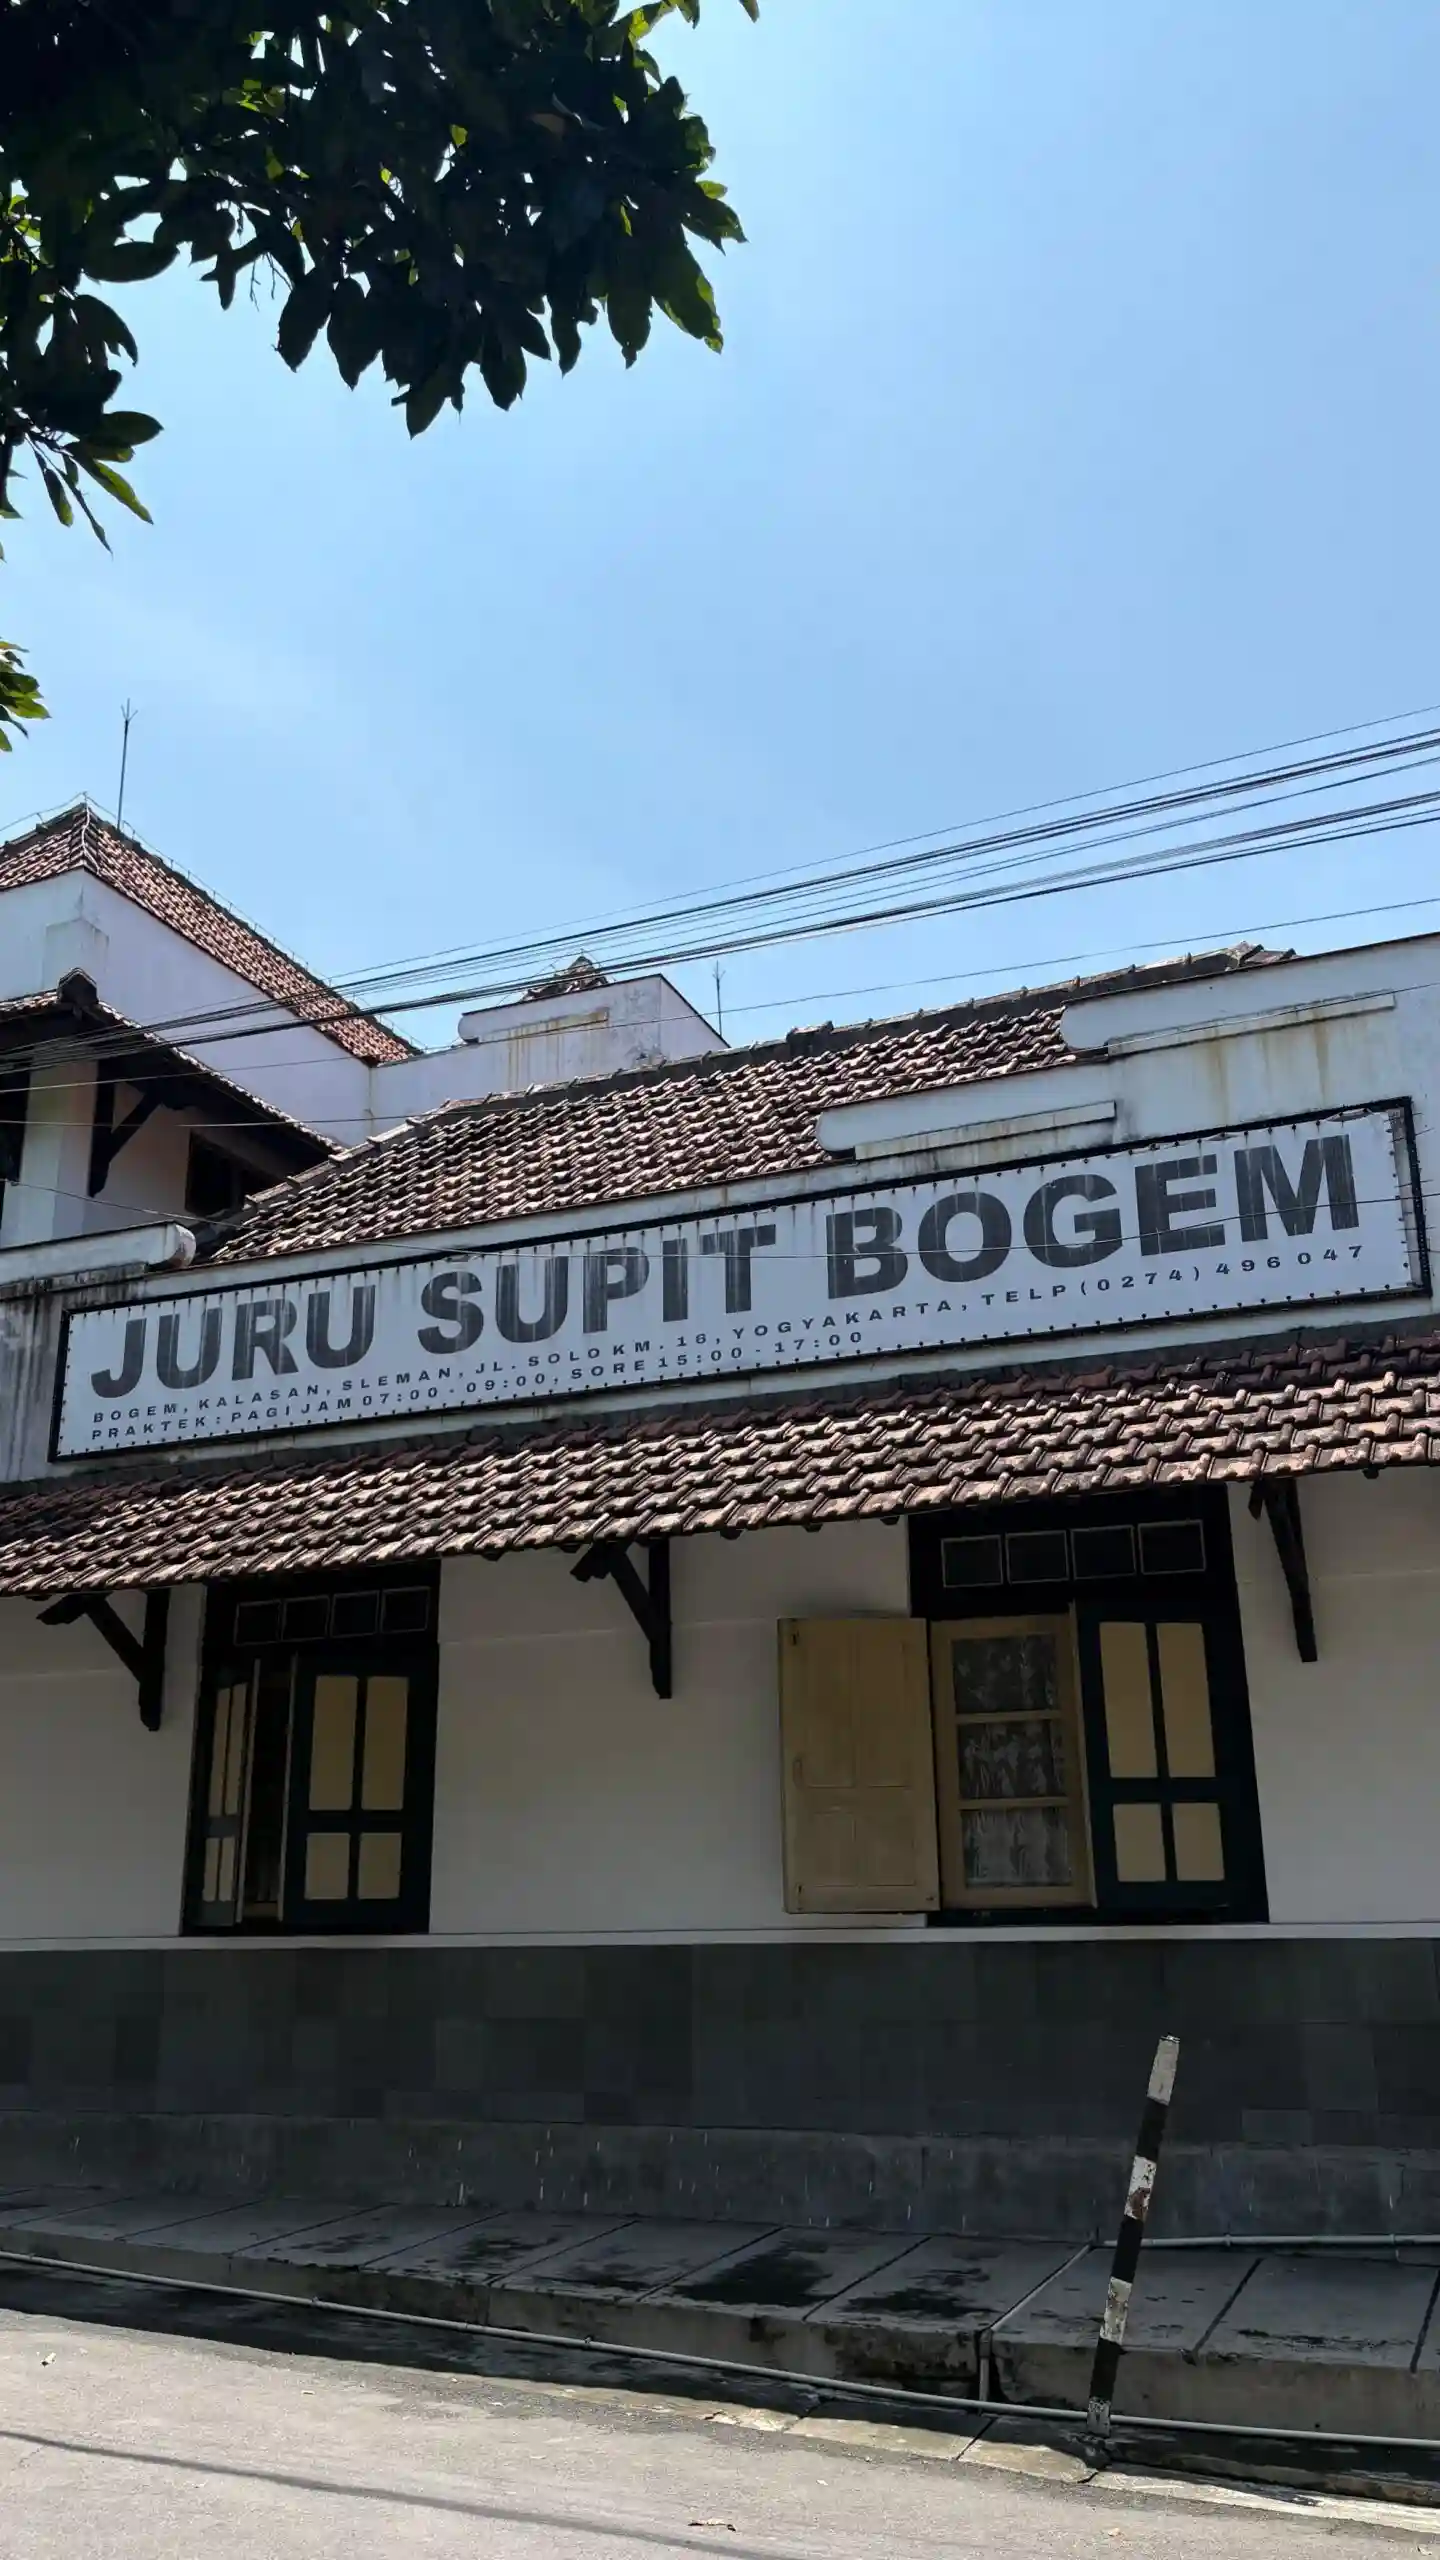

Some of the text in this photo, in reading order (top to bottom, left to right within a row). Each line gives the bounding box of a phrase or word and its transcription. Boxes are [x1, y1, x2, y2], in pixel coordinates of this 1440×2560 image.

[91, 1134, 1359, 1398] JURU SUPIT BOGEM
[93, 1403, 188, 1424] BOGEM,
[199, 1384, 331, 1411] KALASAN,
[342, 1367, 463, 1392] SLEMAN,
[474, 1360, 516, 1376] JL.
[528, 1348, 600, 1368] SOLO
[612, 1340, 664, 1357] KM.
[732, 1300, 967, 1340] YOGYAKARTA,
[981, 1284, 1066, 1306] TELP
[1080, 1266, 1200, 1296] (0274)
[1215, 1255, 1281, 1275] 496
[1297, 1244, 1363, 1265] 047
[231, 1405, 290, 1423] PAGI
[300, 1398, 351, 1414] JAM
[362, 1387, 438, 1406] 07:00
[571, 1360, 645, 1380] SORE
[658, 1347, 742, 1368] 15:00
[775, 1331, 862, 1353] 17:00
